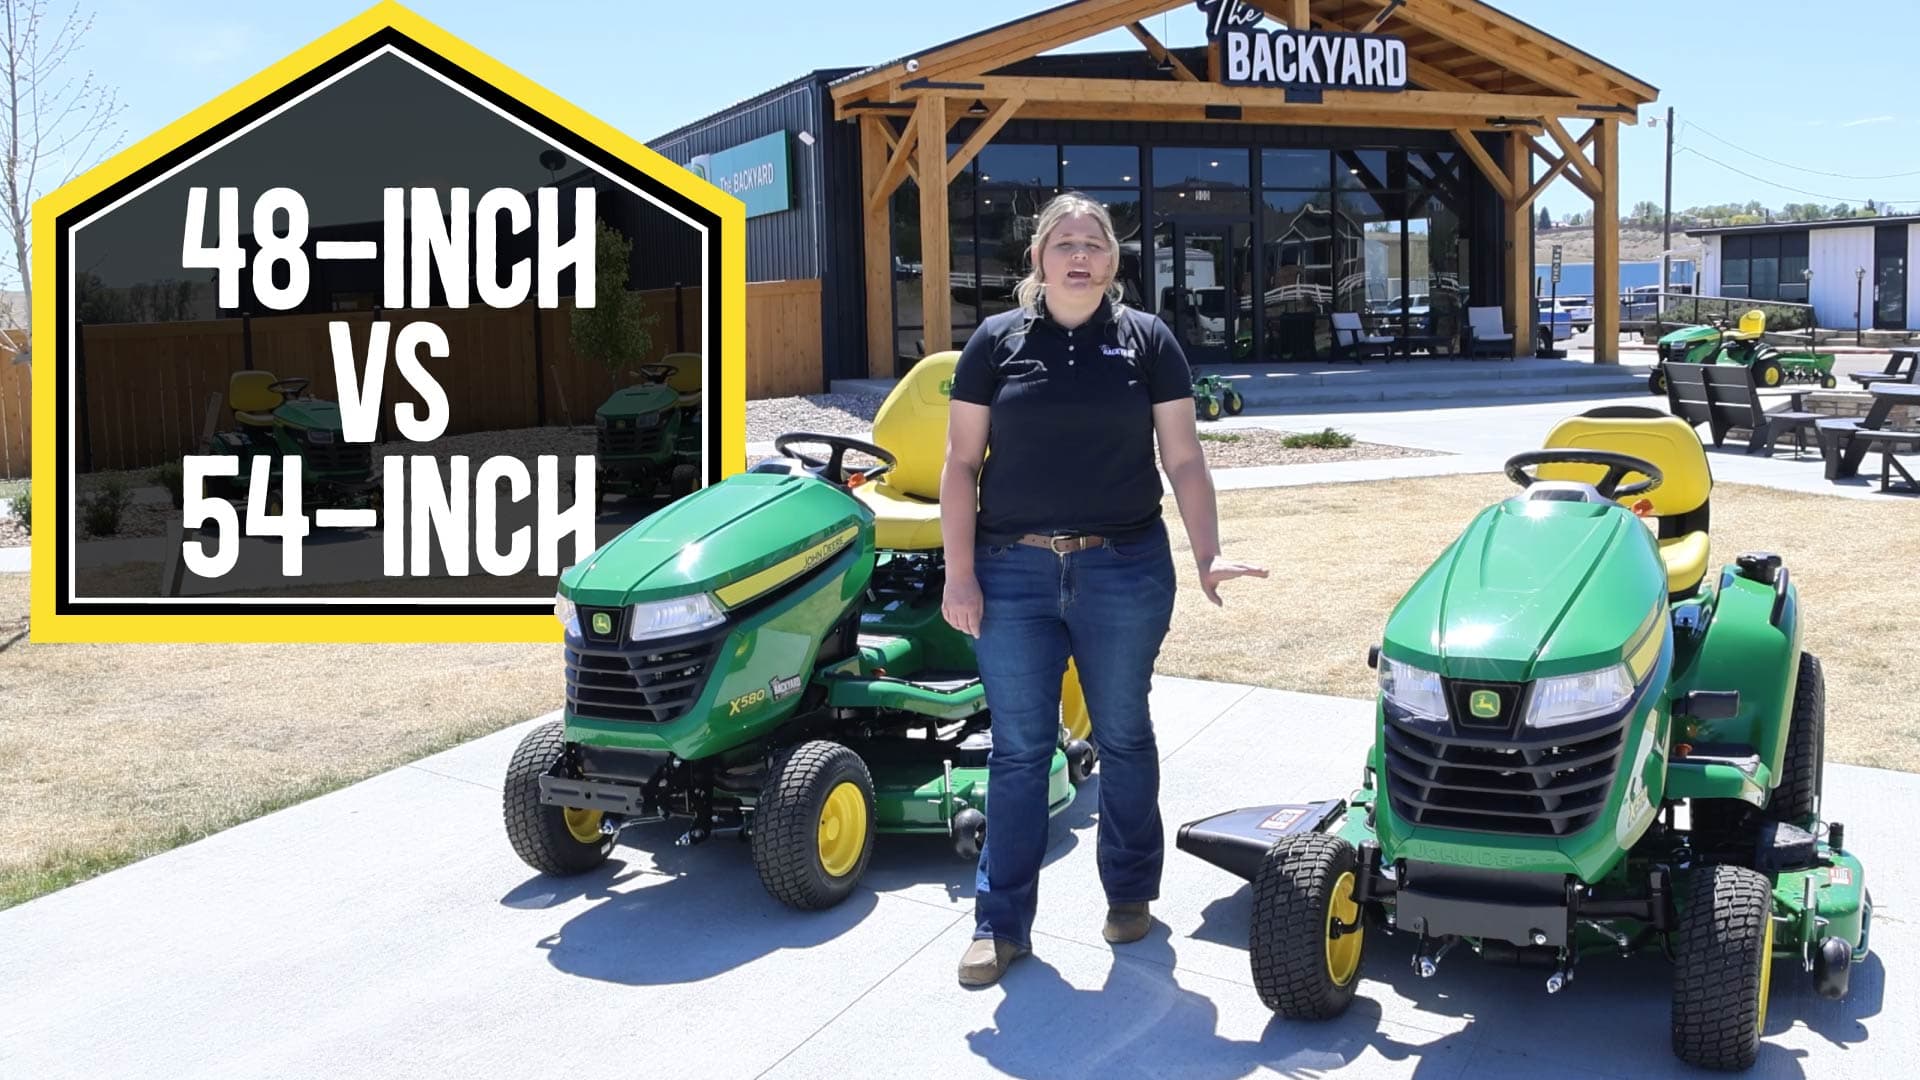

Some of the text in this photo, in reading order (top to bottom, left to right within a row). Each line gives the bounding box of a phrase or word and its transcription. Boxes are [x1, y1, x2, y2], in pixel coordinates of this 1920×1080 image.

[1204, 0, 1262, 35] The
[1227, 32, 1407, 87] BACKYARD
[733, 162, 774, 193] BACKYARD
[804, 536, 844, 568] JOHN DEERE
[729, 689, 765, 716] X580
[1413, 843, 1473, 864] JOHN
